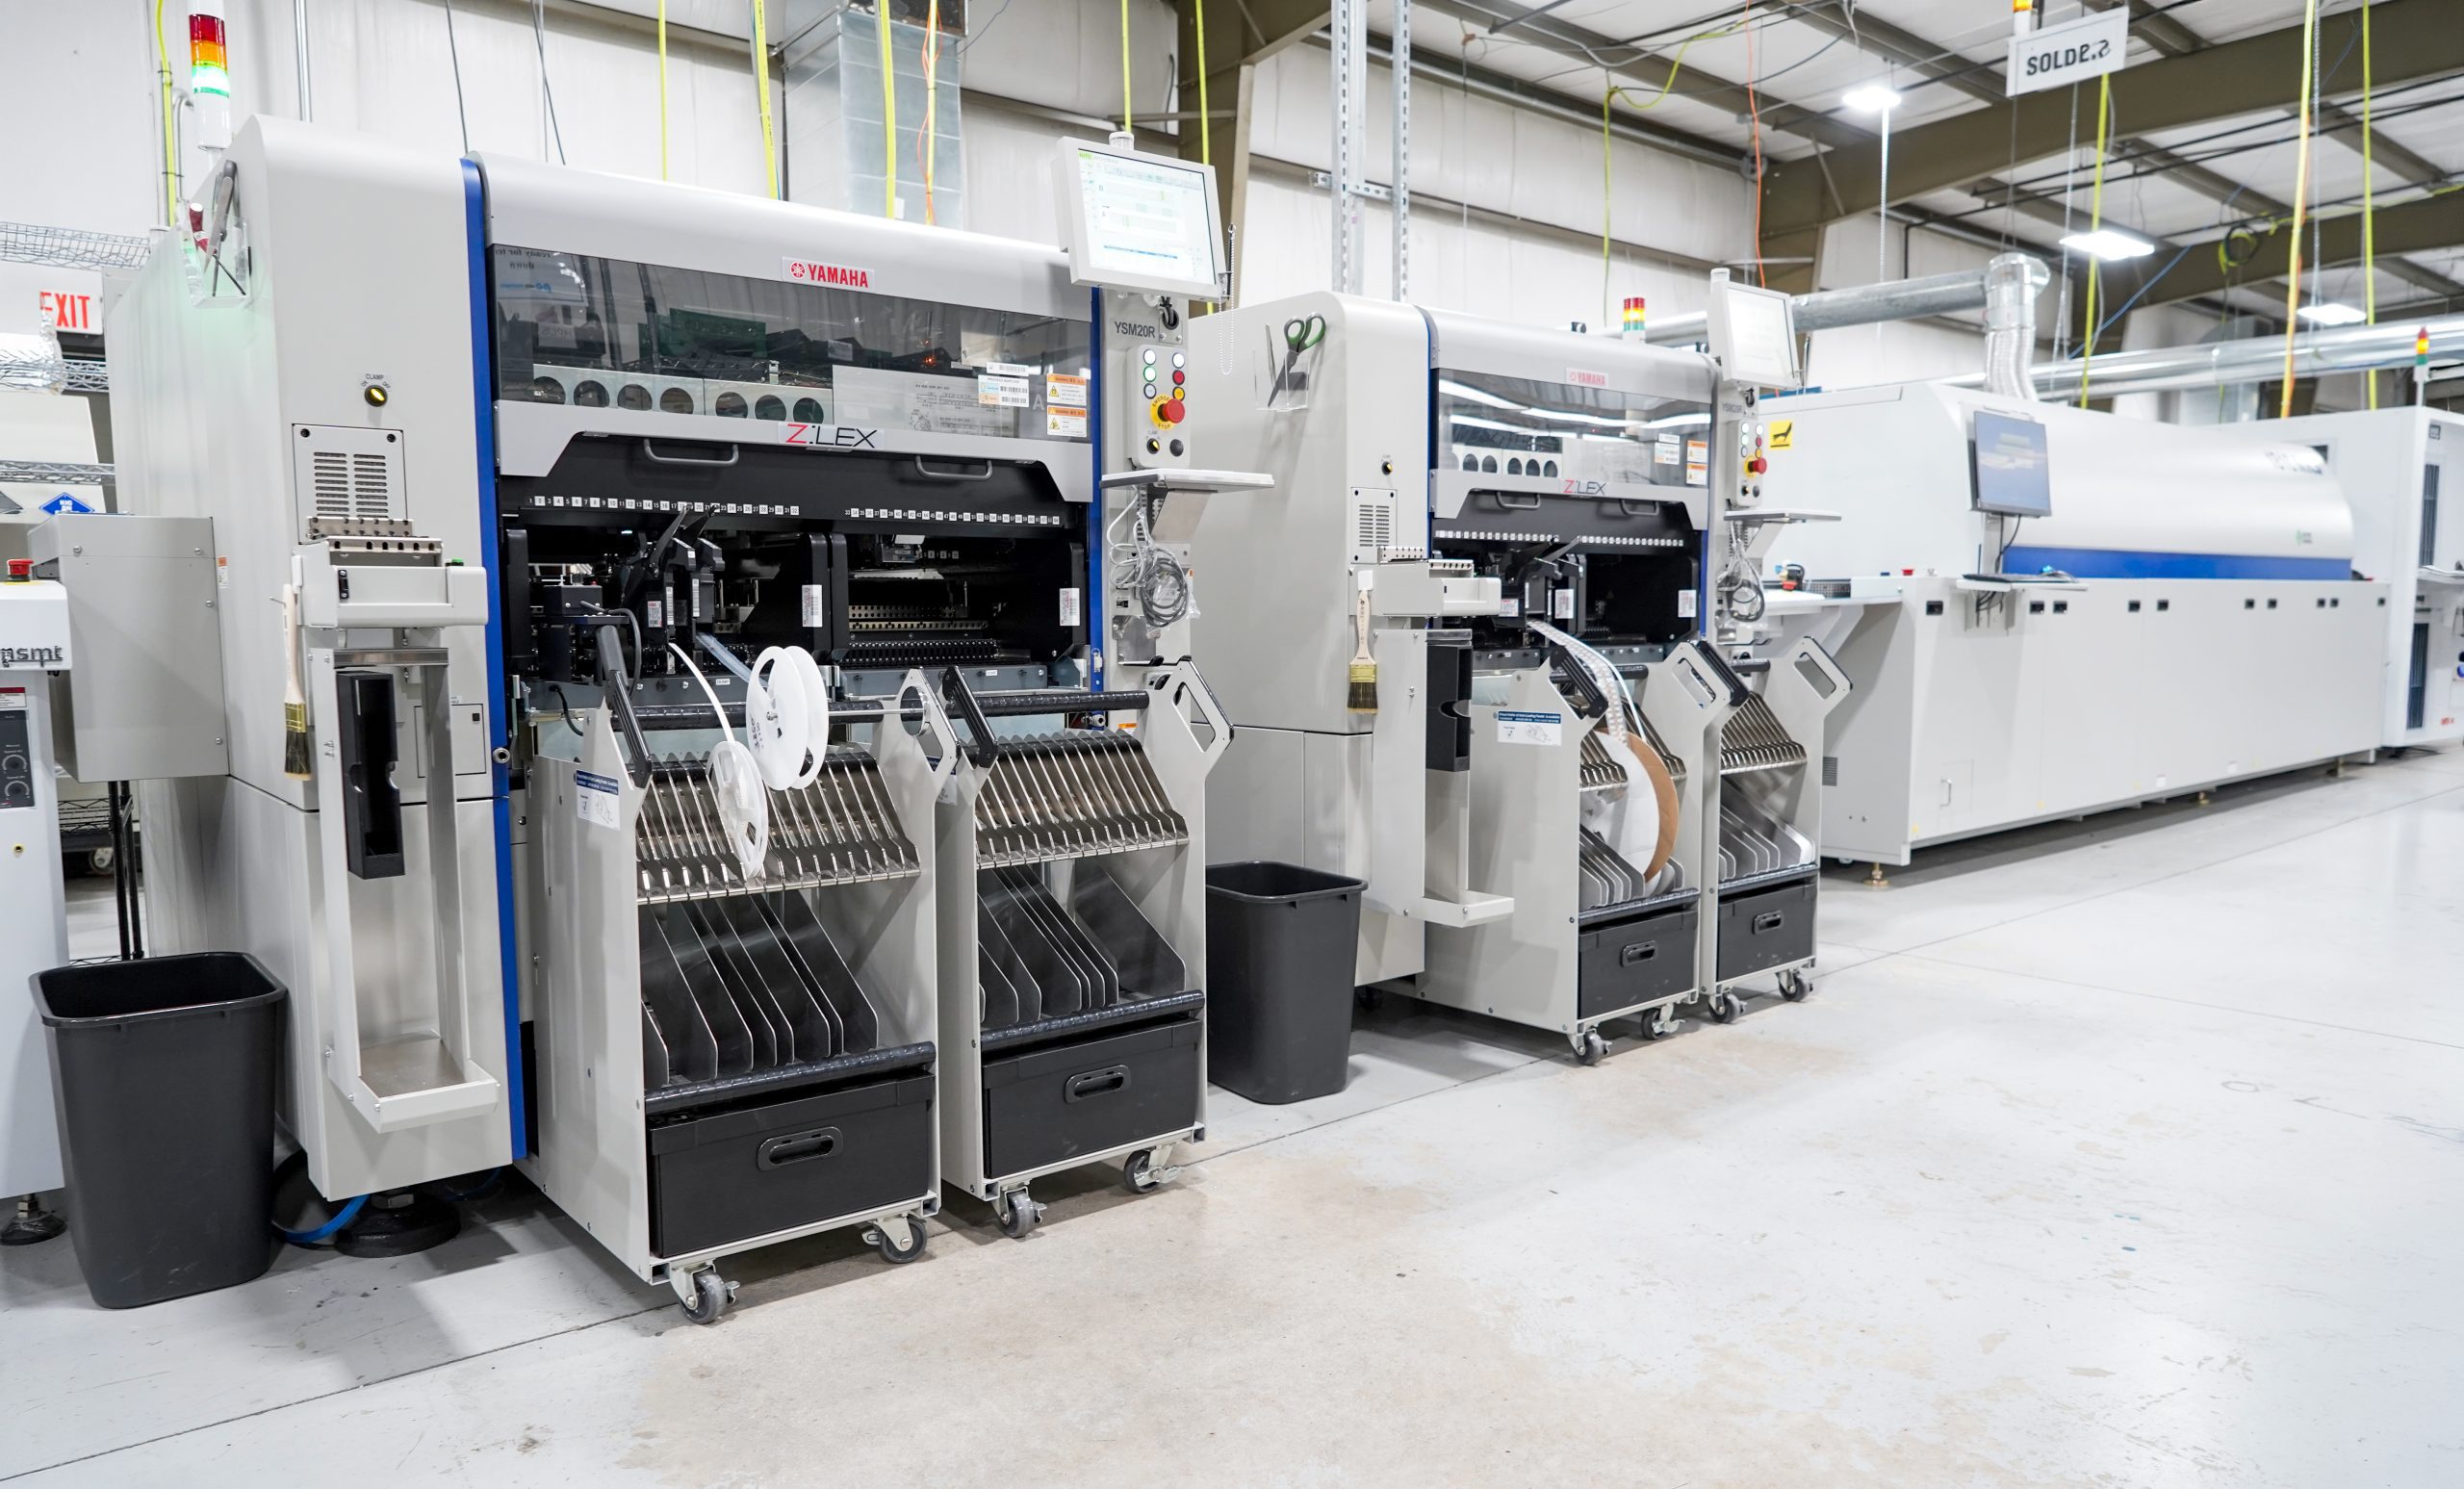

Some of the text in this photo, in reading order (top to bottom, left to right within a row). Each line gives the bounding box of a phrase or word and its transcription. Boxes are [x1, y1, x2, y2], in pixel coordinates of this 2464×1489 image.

[808, 263, 869, 289] YAMAHA
[1114, 321, 1156, 339] YSM20R
[1578, 372, 1606, 386] YAMAHA
[1032, 394, 1045, 411] A
